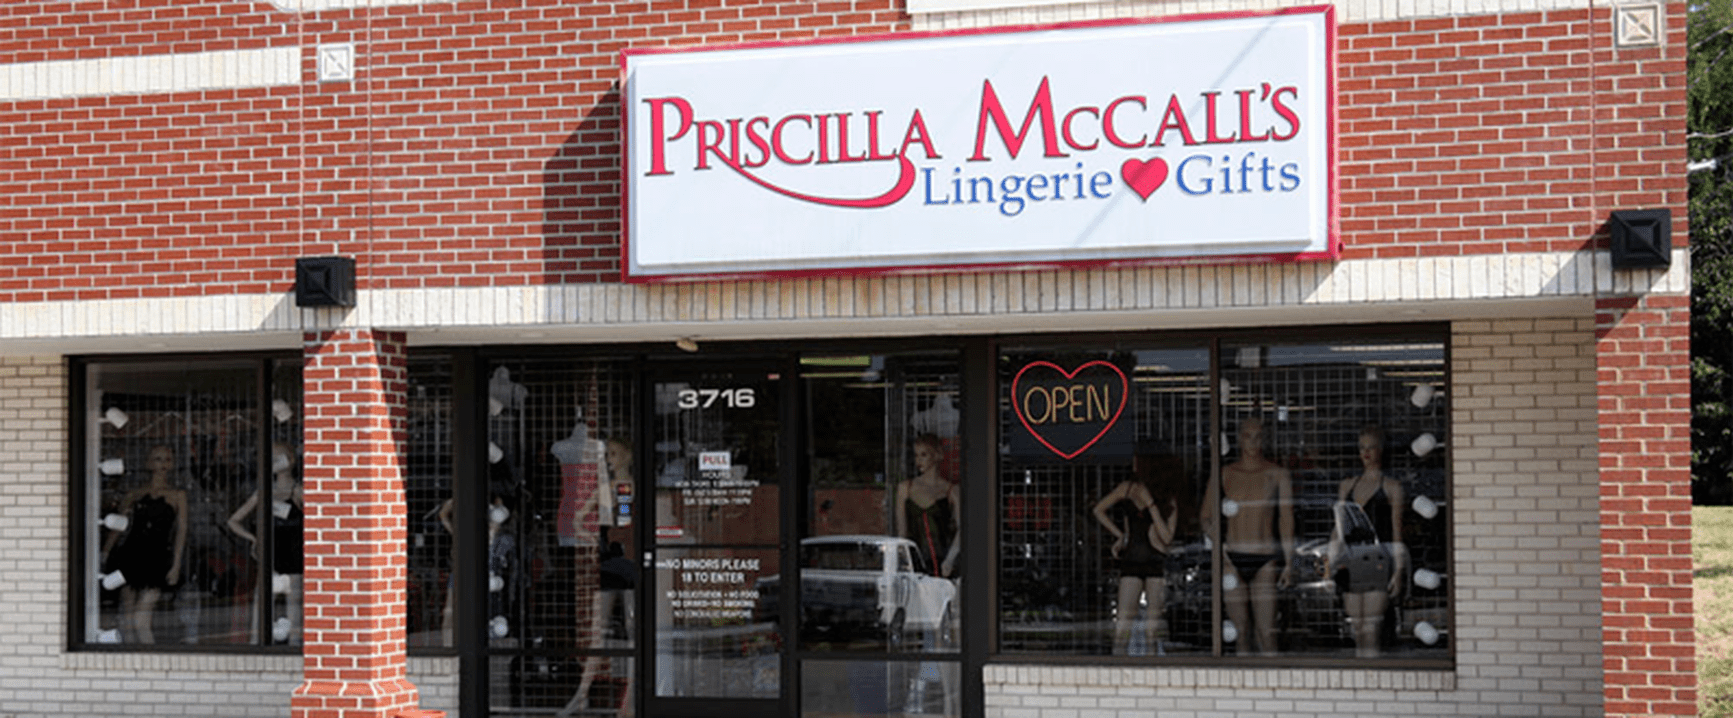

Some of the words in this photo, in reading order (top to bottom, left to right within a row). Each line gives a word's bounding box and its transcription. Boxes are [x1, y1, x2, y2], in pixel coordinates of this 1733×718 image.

[642, 96, 943, 209] PRISCILLA
[921, 162, 1114, 217] Lingerie
[1176, 151, 1302, 197] Gifts
[677, 388, 756, 409] 3716
[1023, 383, 1111, 425] OPEN
[682, 558, 720, 570] MINORS
[721, 558, 760, 571] PLEASE
[682, 571, 692, 583] 18
[694, 571, 709, 583] TO
[710, 571, 745, 583] ENTER
